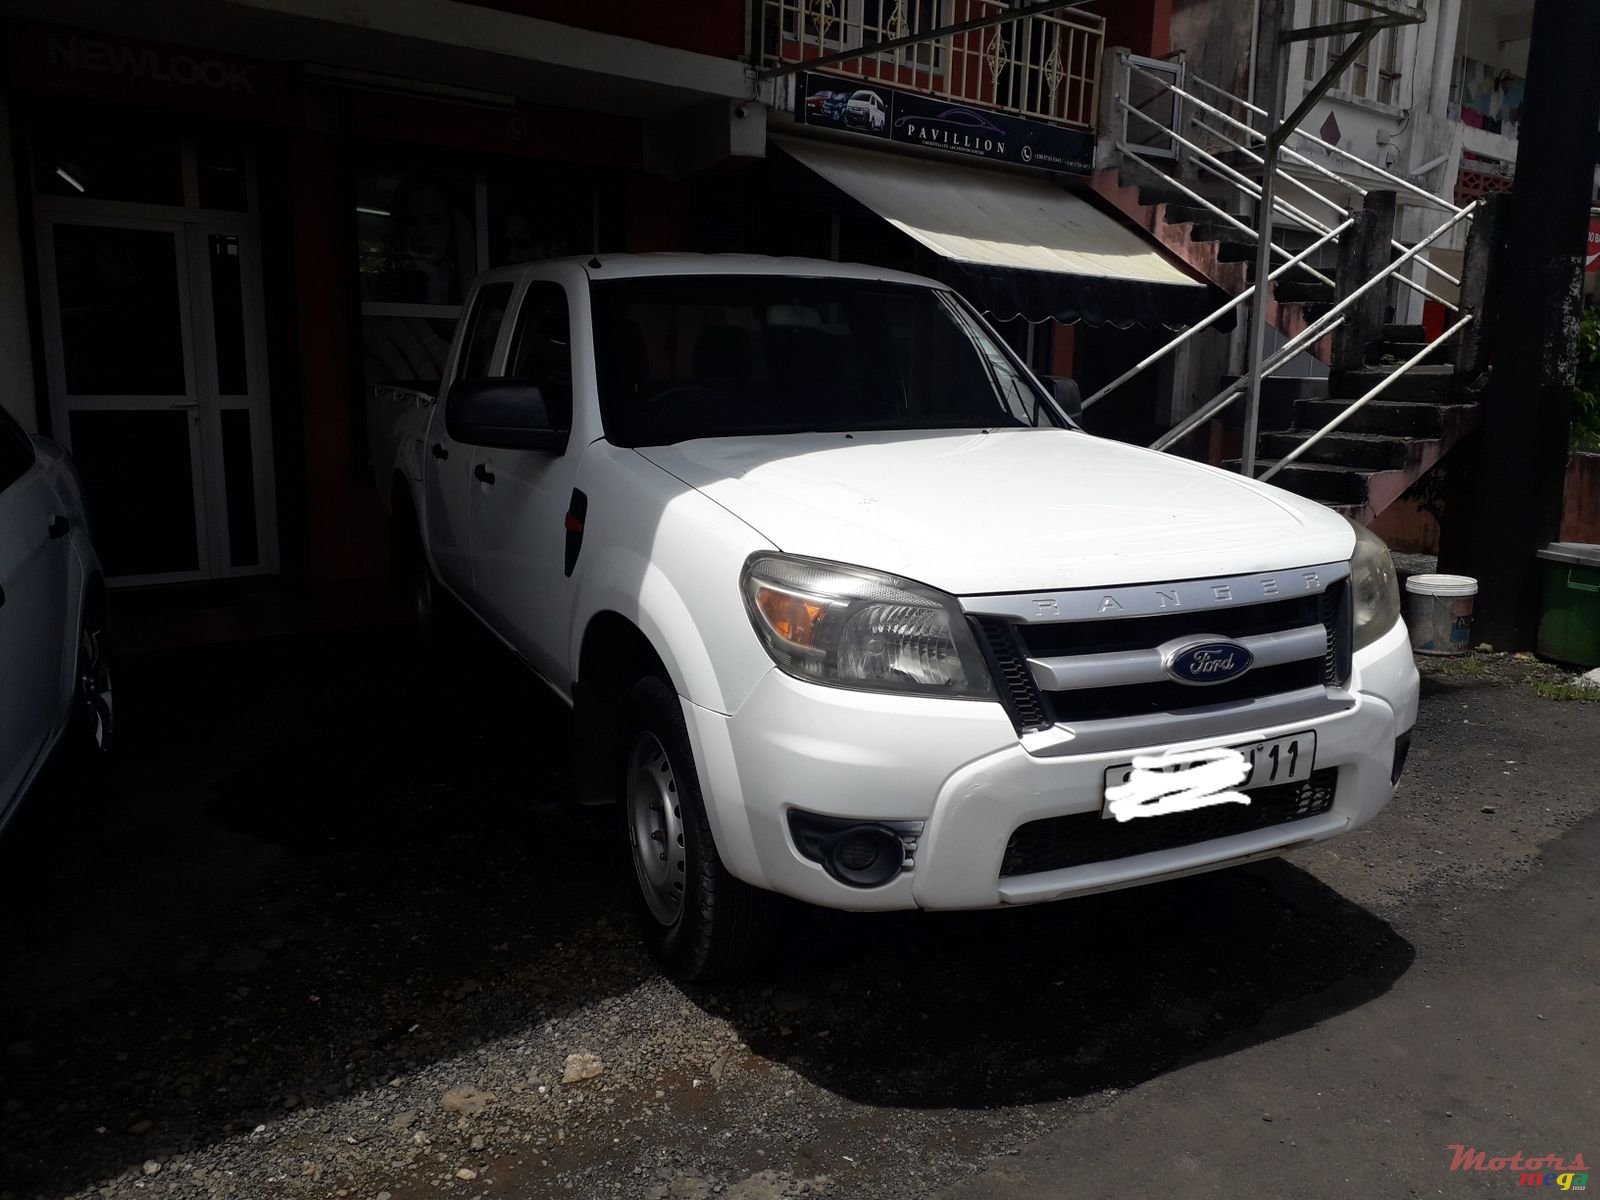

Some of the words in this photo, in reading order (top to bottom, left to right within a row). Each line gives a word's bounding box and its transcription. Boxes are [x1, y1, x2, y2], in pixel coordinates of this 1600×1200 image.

[907, 123, 1006, 155] PAVILLION
[1031, 571, 1321, 617] RANGER
[1189, 649, 1235, 676] Ford
